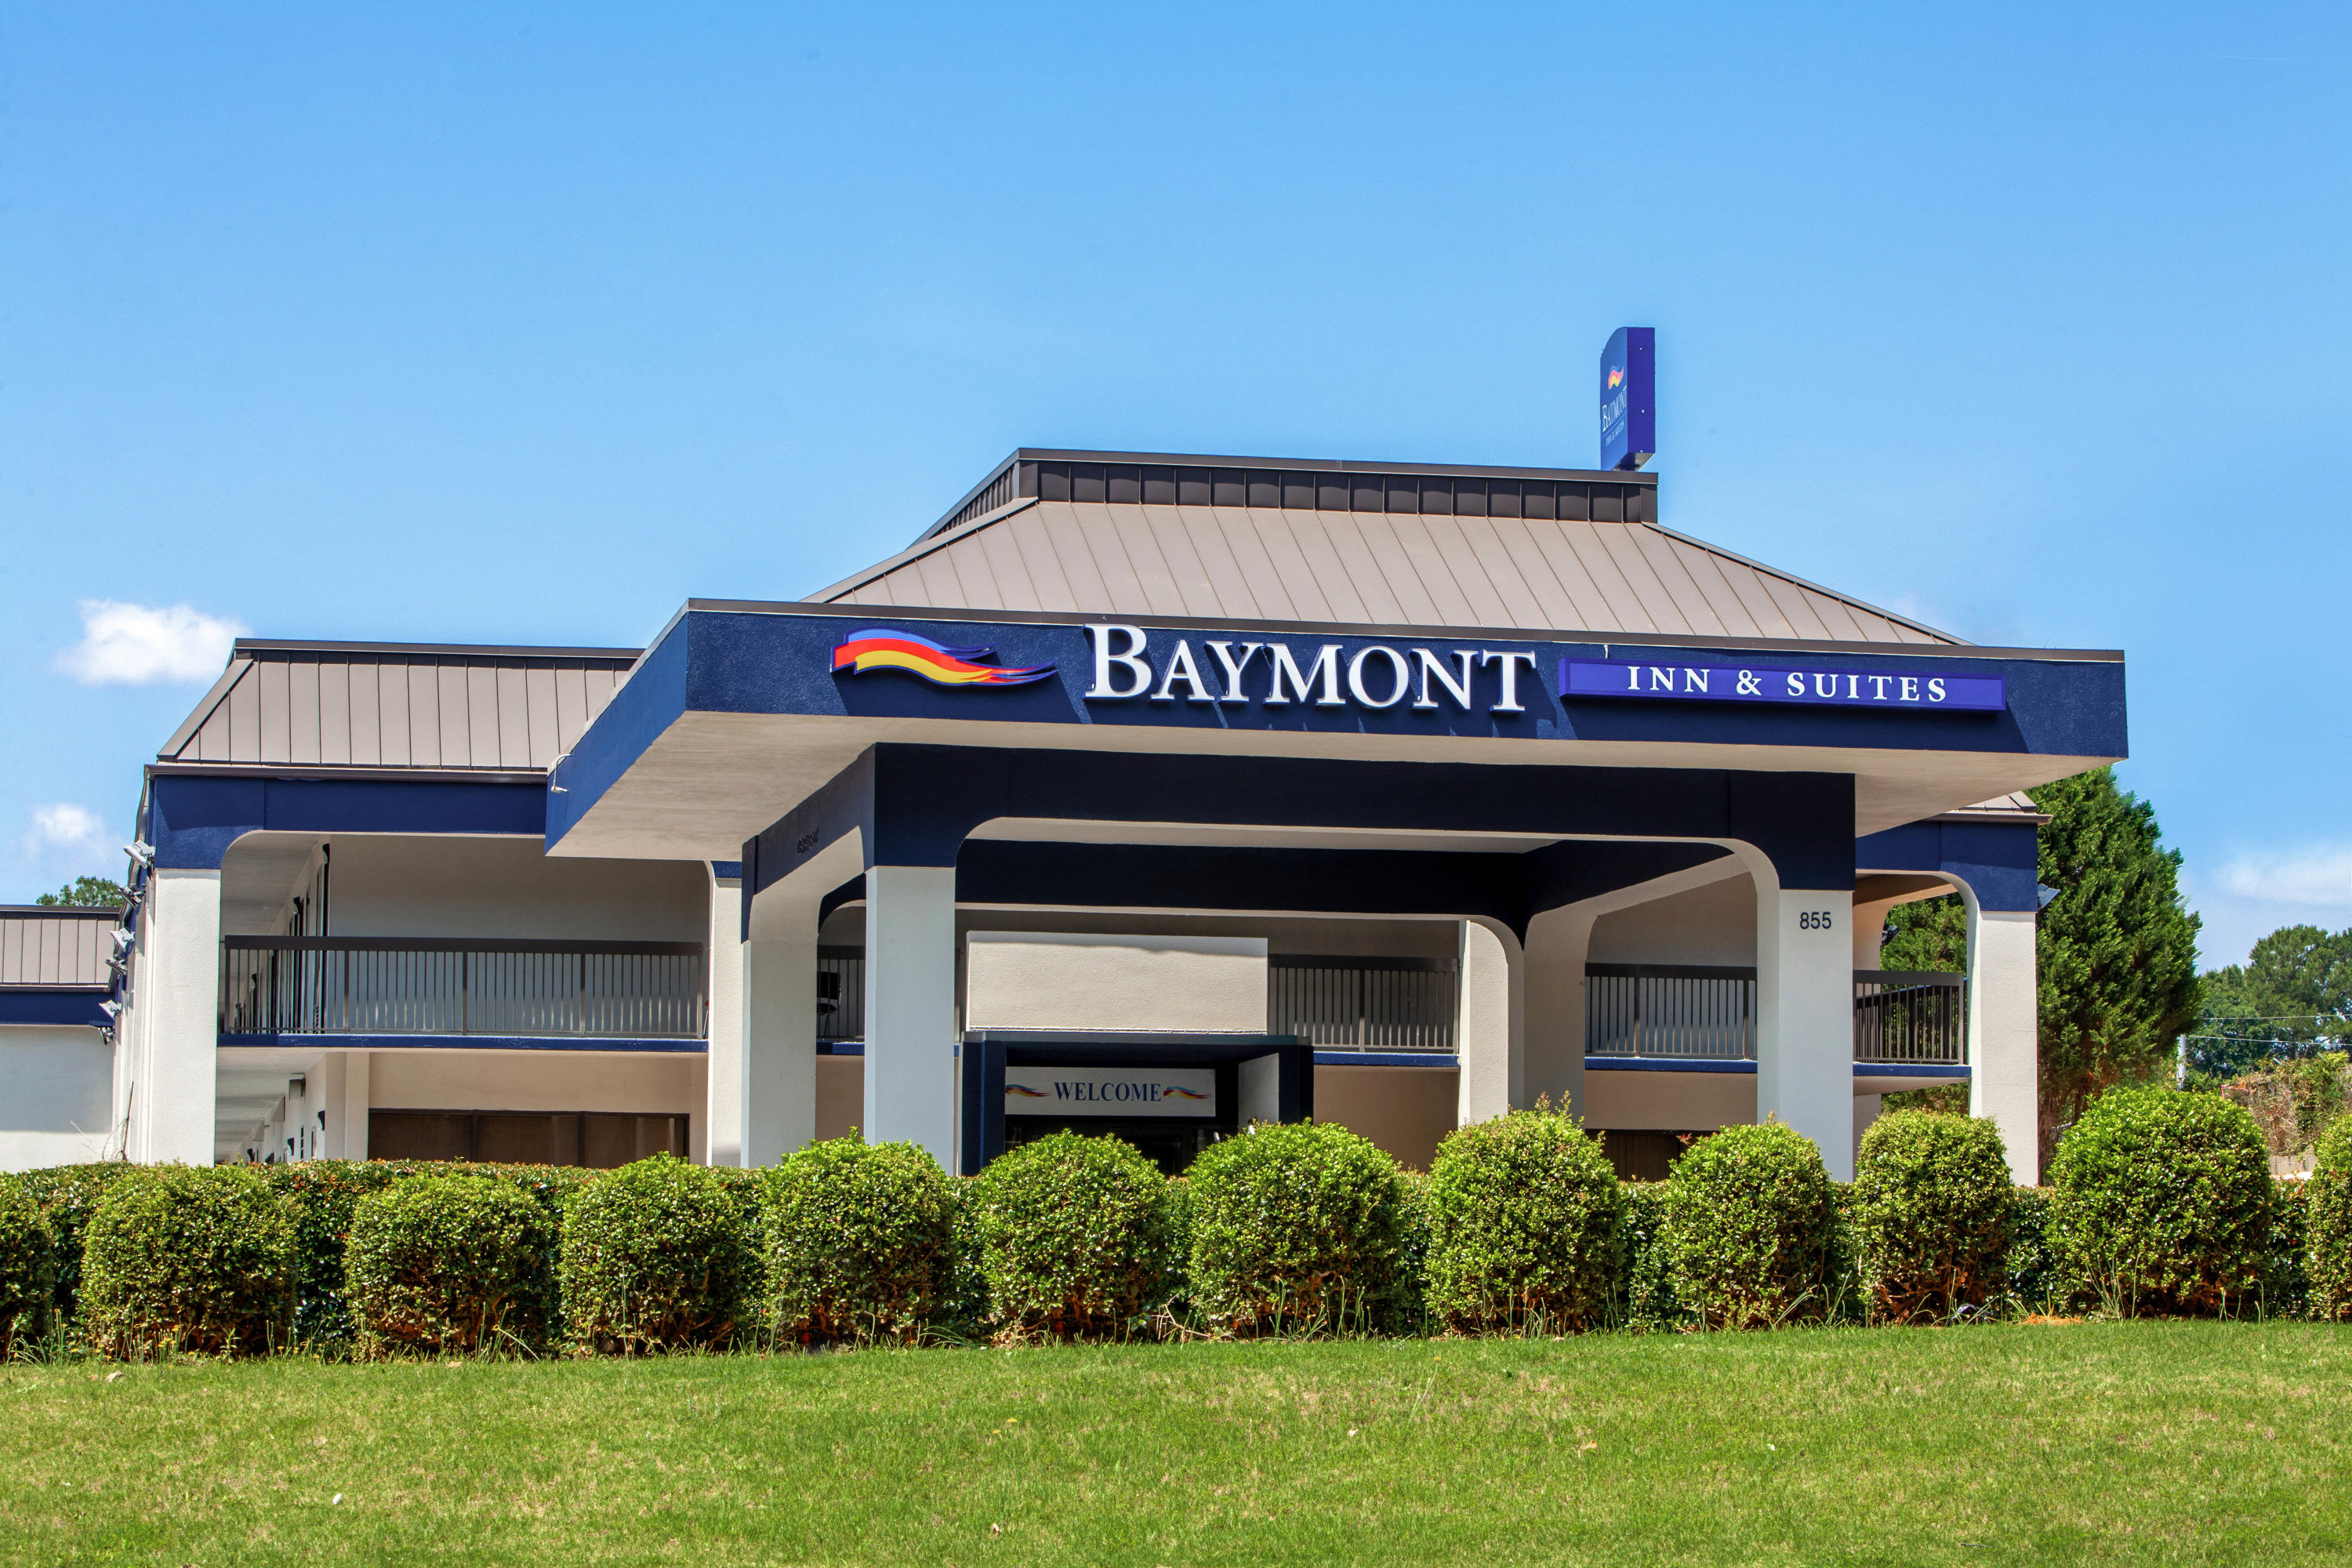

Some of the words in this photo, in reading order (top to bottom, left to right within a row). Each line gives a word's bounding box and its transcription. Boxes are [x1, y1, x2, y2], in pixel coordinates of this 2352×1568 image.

[1083, 623, 1536, 712] BAYMONT
[1627, 666, 1711, 693] INN
[1736, 670, 1762, 696] &
[1787, 672, 1947, 702] SUITES
[1799, 912, 1832, 930] 855
[1054, 1082, 1162, 1102] WELCOME
